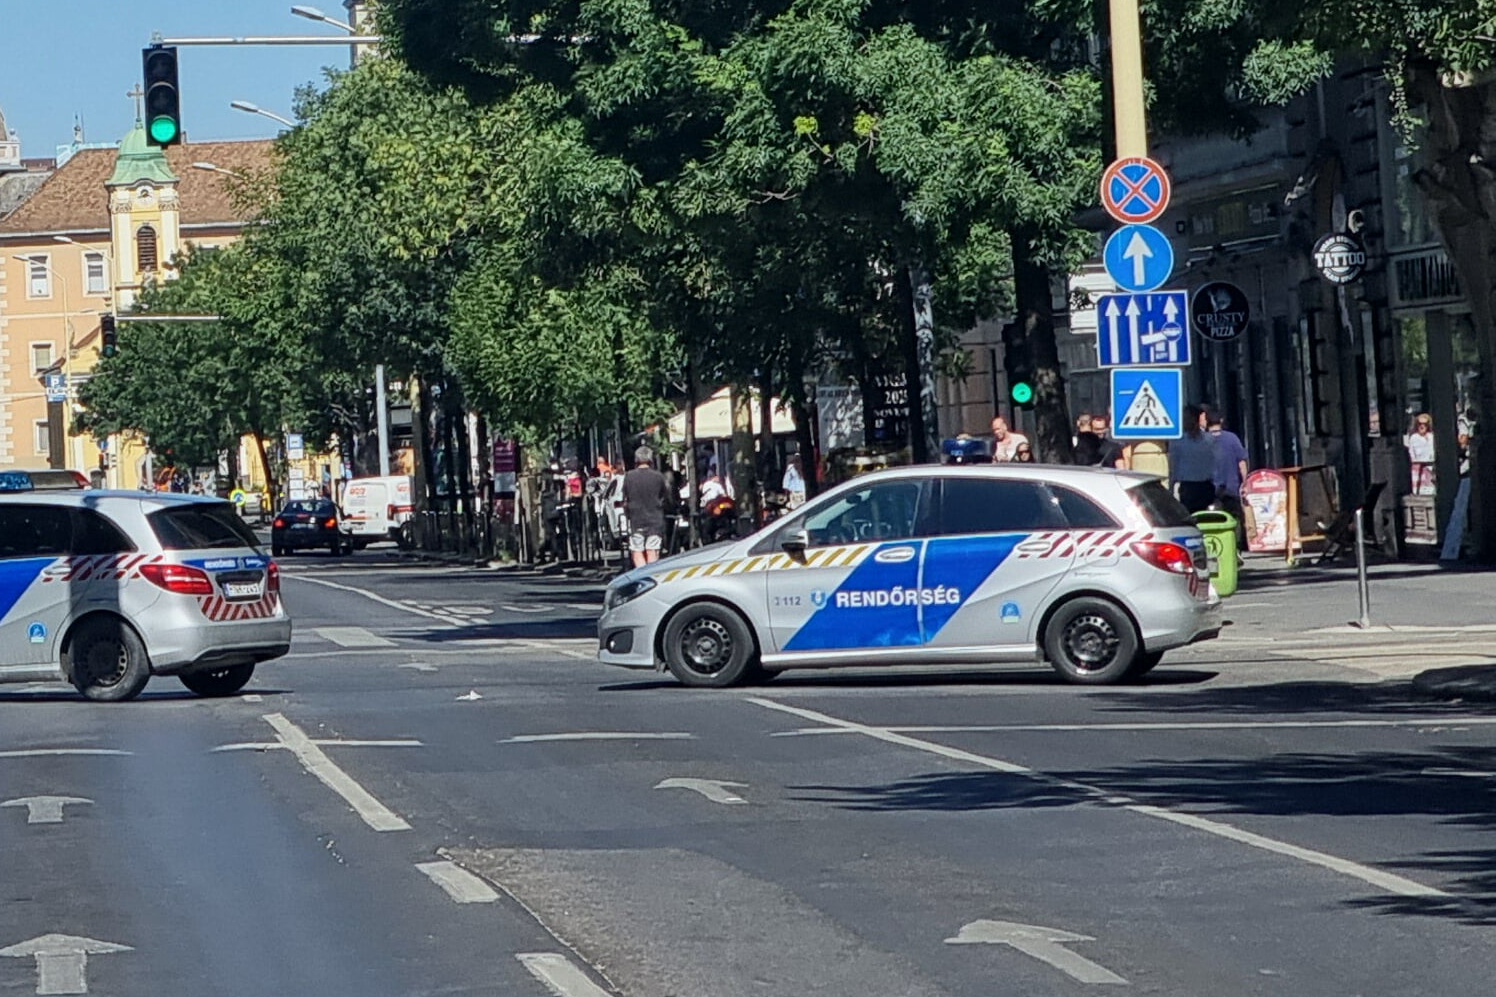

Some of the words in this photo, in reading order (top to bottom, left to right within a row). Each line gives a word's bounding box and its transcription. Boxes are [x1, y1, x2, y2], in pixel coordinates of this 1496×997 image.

[1314, 252, 1365, 268] TATTOO
[1197, 312, 1245, 325] CRUSTY
[1210, 326, 1235, 337] PIZZA
[783, 596, 801, 606] 112
[836, 586, 960, 608] RENDŐRSÉG
